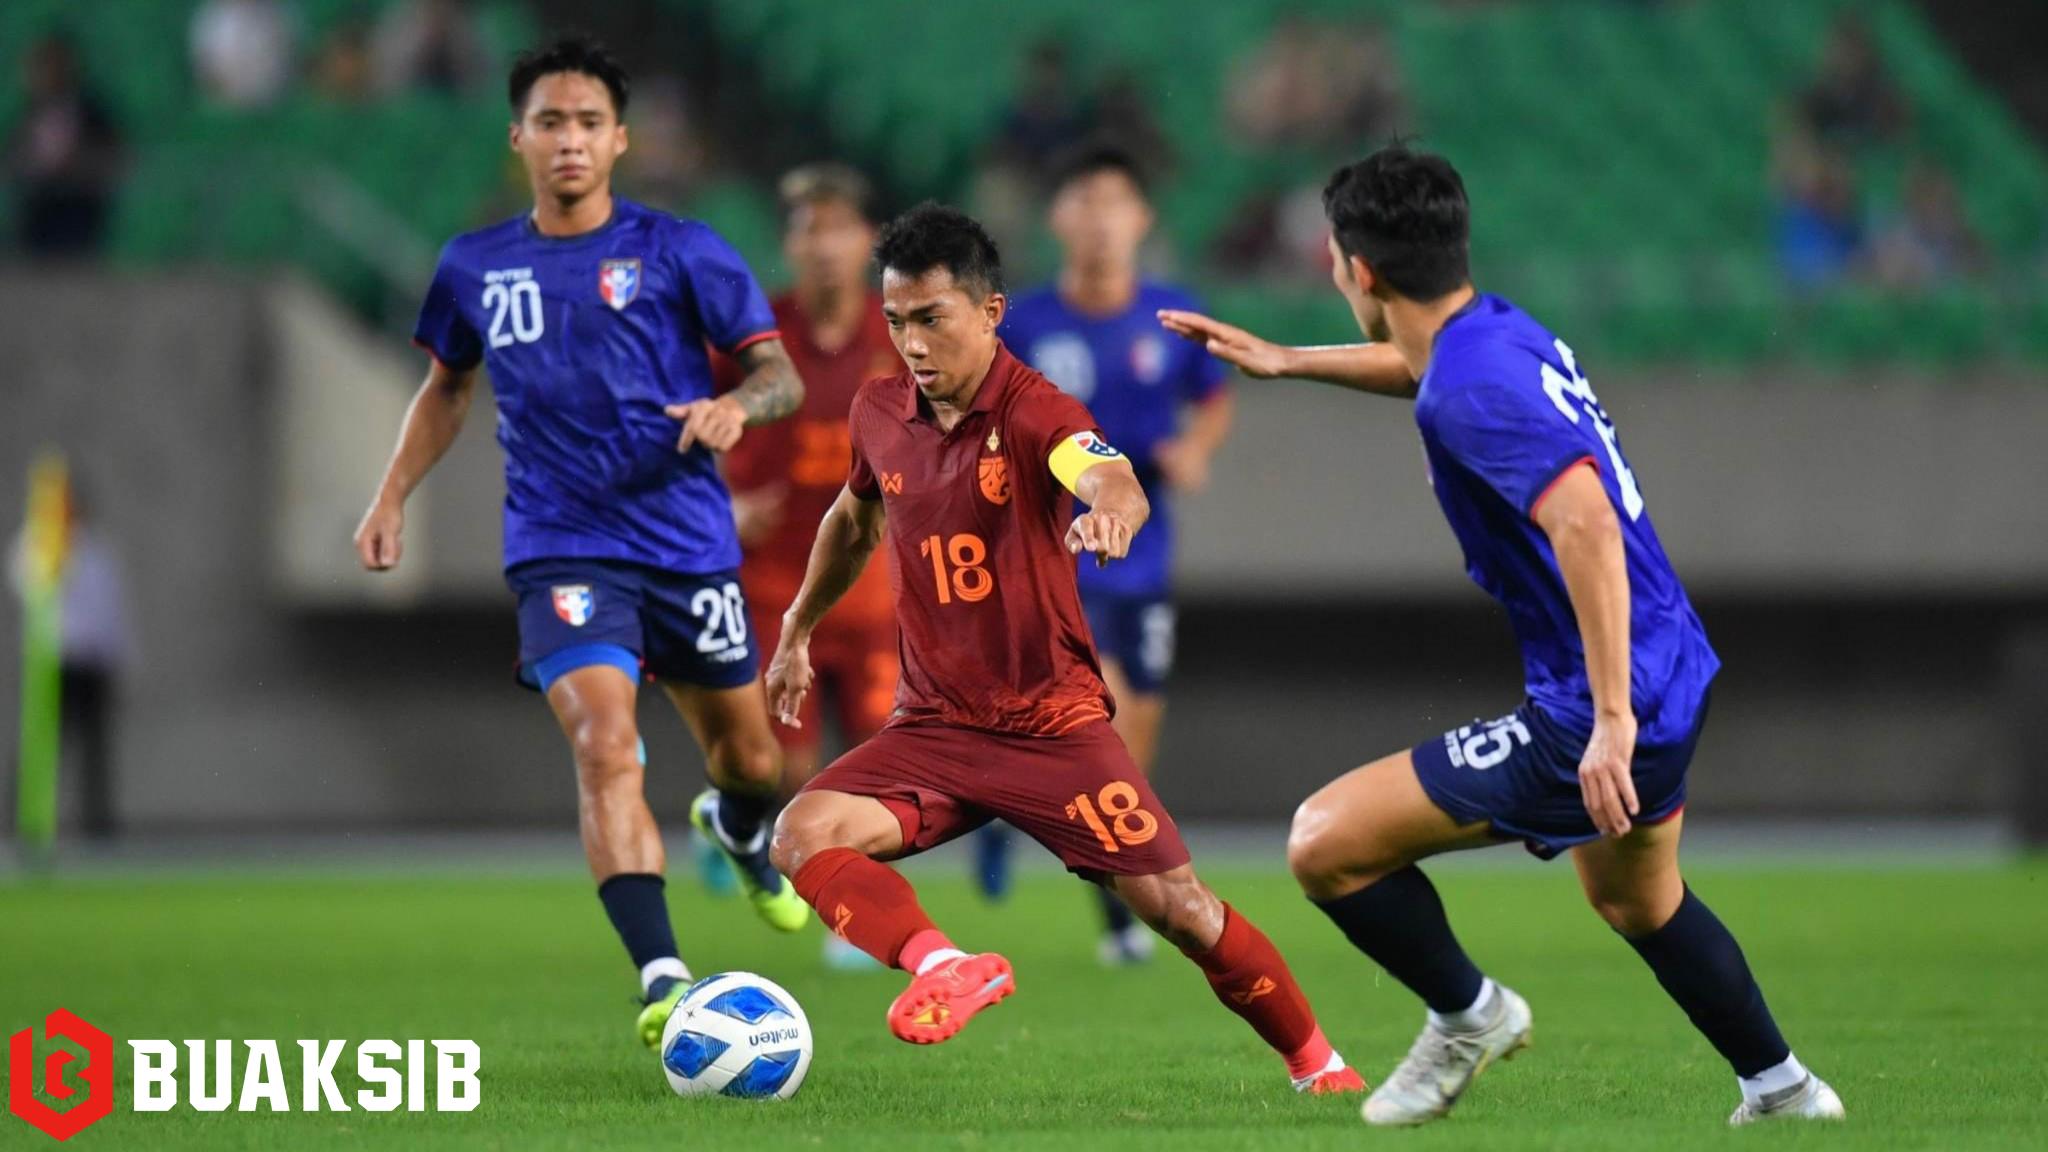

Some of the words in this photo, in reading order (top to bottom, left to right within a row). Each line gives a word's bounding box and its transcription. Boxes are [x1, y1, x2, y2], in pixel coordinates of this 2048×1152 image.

[481, 280, 544, 349] 20
[921, 533, 993, 604] 18
[691, 582, 748, 653] 20
[1065, 781, 1158, 853] 18
[749, 1026, 799, 1047] molten
